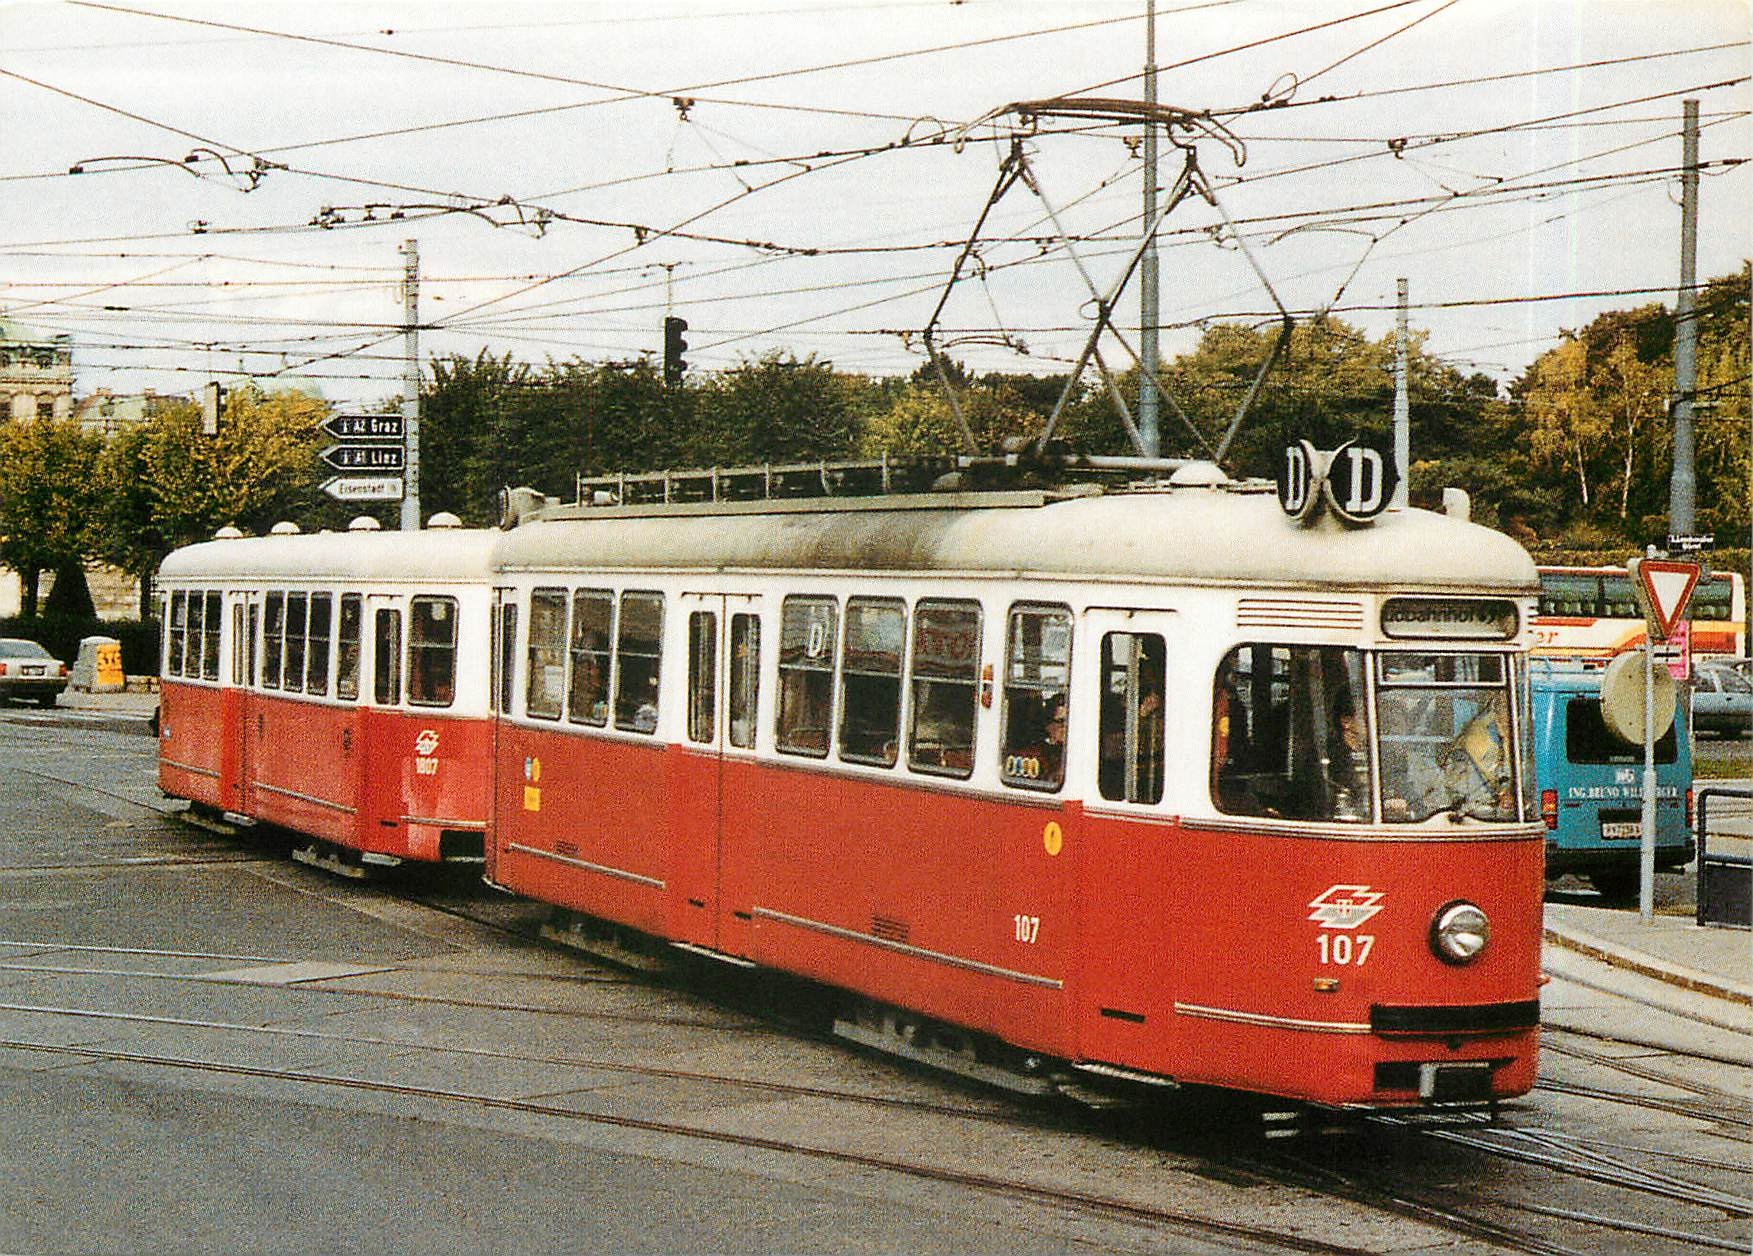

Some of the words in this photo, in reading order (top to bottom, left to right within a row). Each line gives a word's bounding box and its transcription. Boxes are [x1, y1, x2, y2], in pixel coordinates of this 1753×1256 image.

[371, 418, 398, 433] Graz
[1286, 446, 1306, 511] D
[1346, 447, 1383, 513] D
[1014, 914, 1040, 944] 107
[1316, 933, 1376, 967] 107
